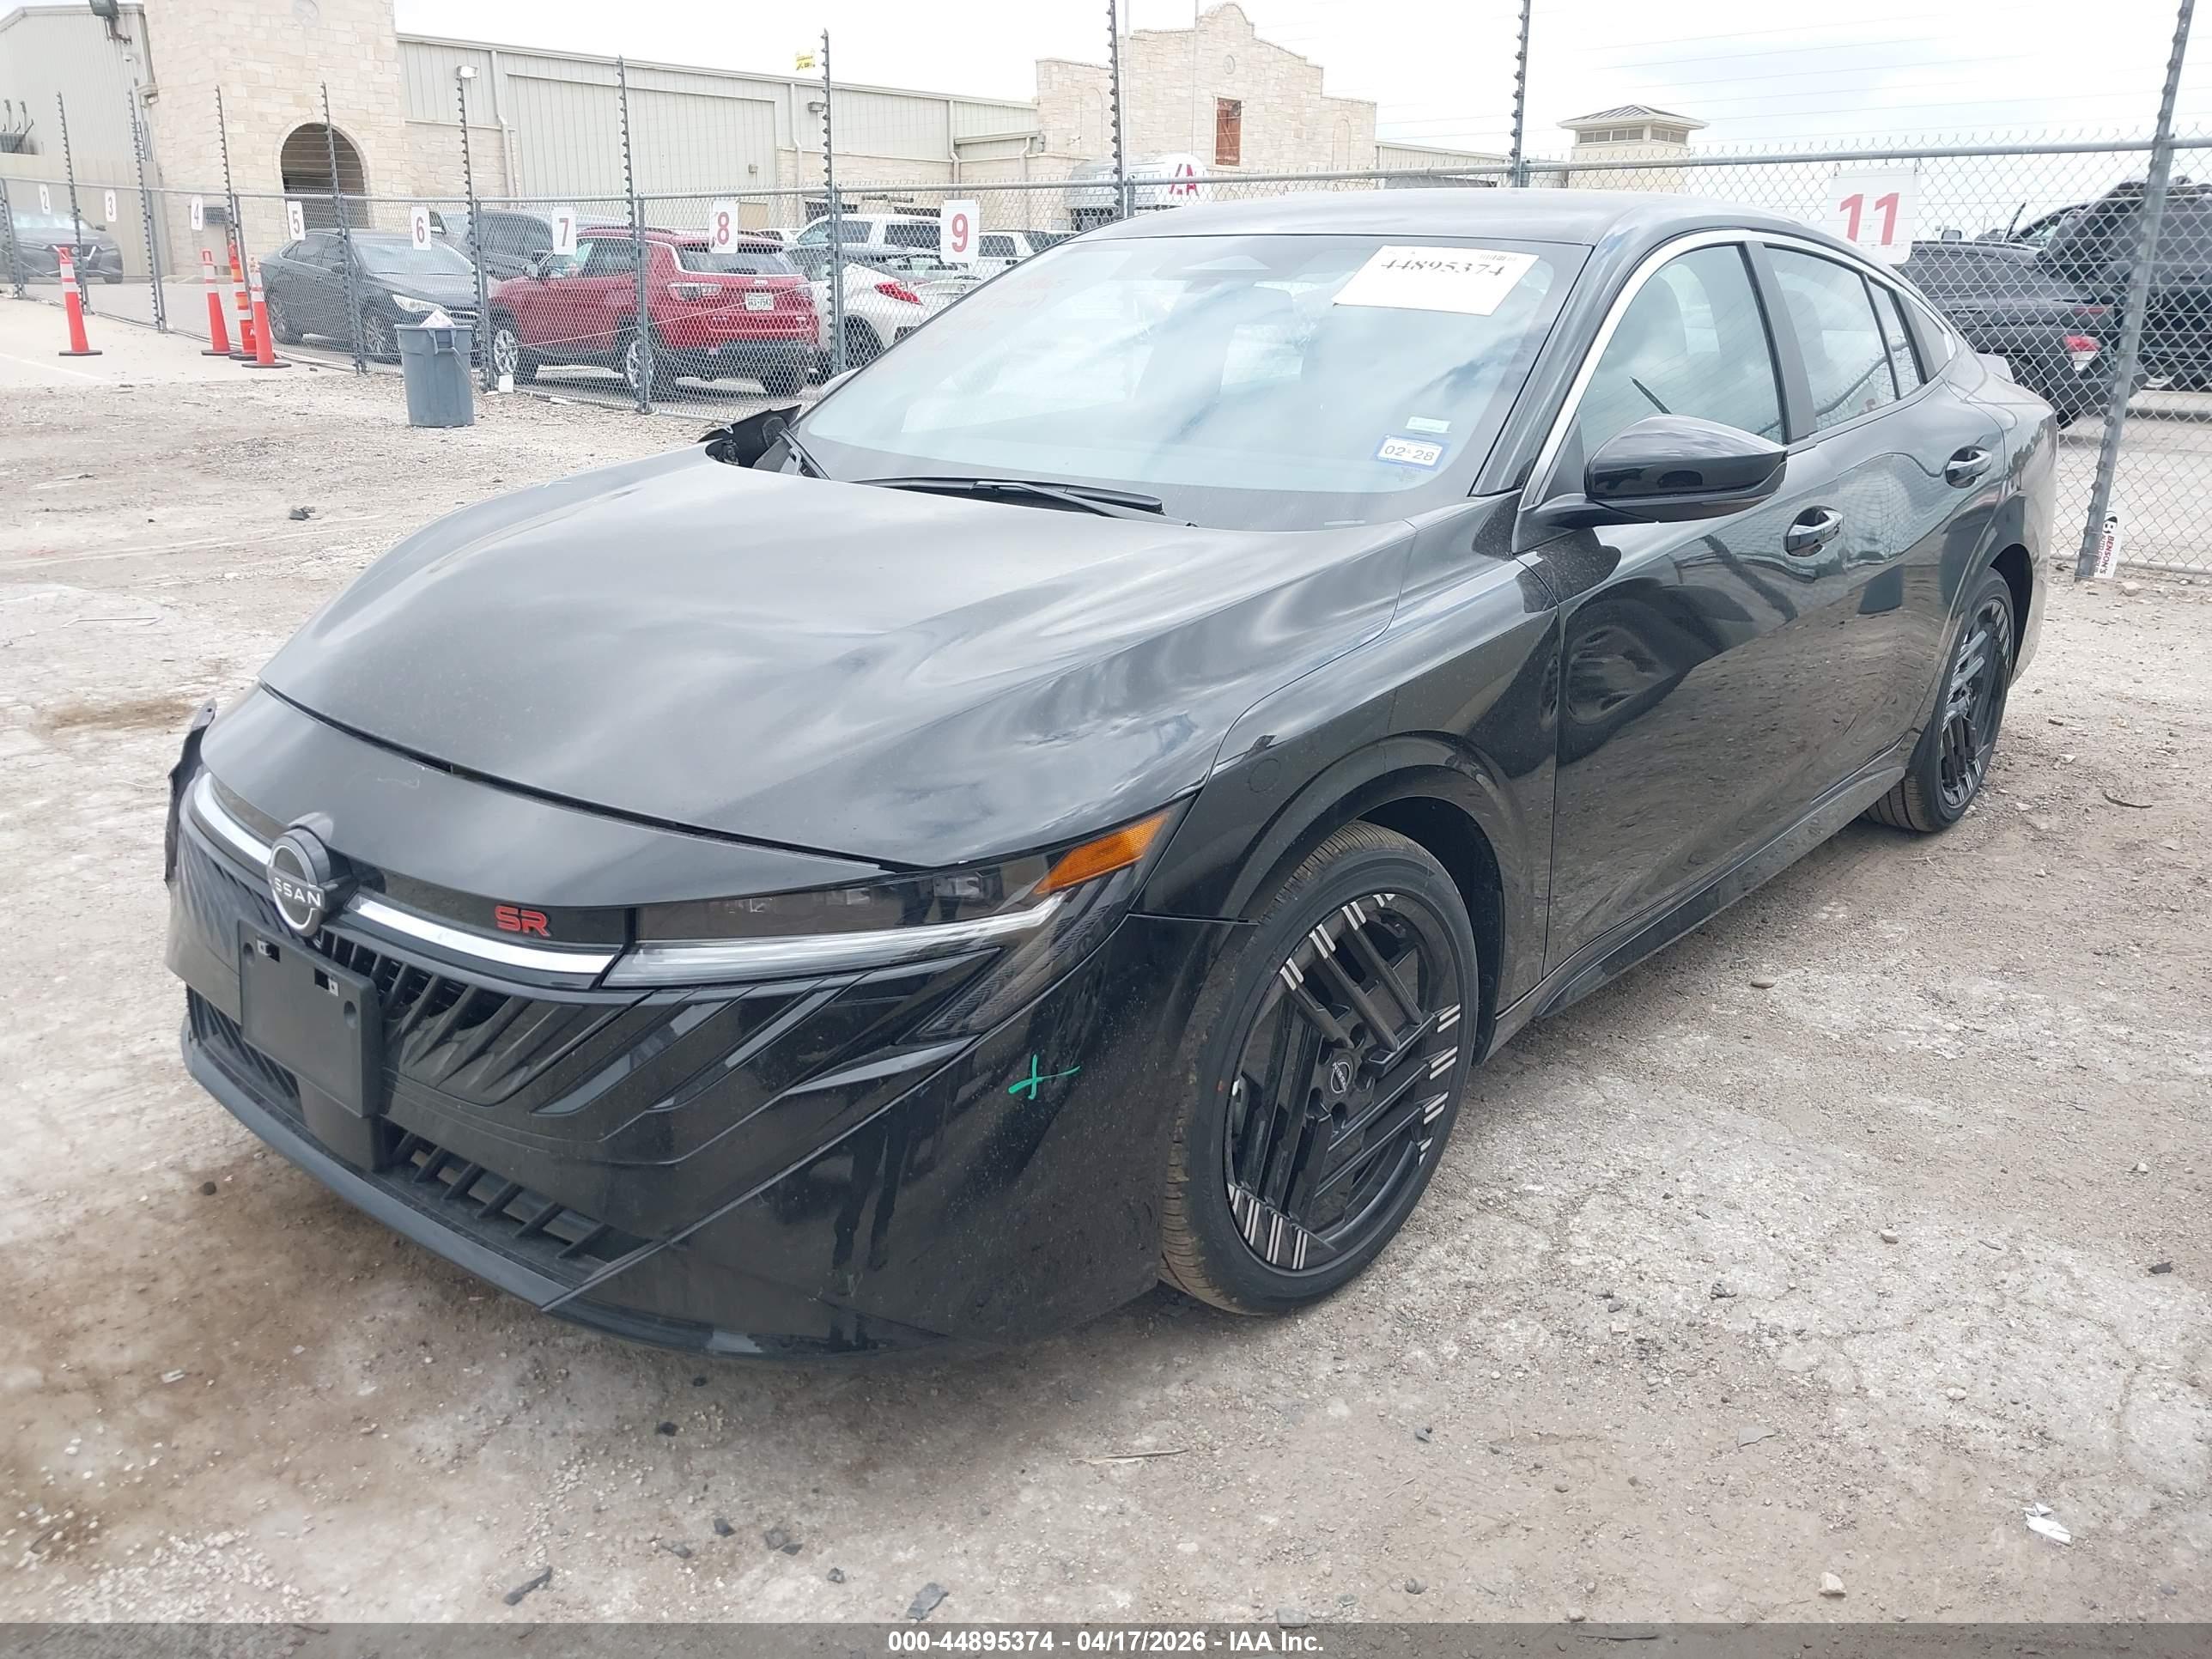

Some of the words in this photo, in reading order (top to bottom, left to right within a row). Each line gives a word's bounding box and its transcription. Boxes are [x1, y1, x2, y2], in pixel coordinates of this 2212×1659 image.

[292, 210, 301, 234] 5
[416, 216, 425, 243] 6
[558, 217, 569, 246] 7
[717, 211, 730, 245] 8
[952, 213, 969, 252] 9
[1839, 192, 1900, 246] 11
[1381, 259, 1505, 276] 44895374
[2099, 535, 2115, 574] BENSON'S
[495, 905, 551, 937] SR
